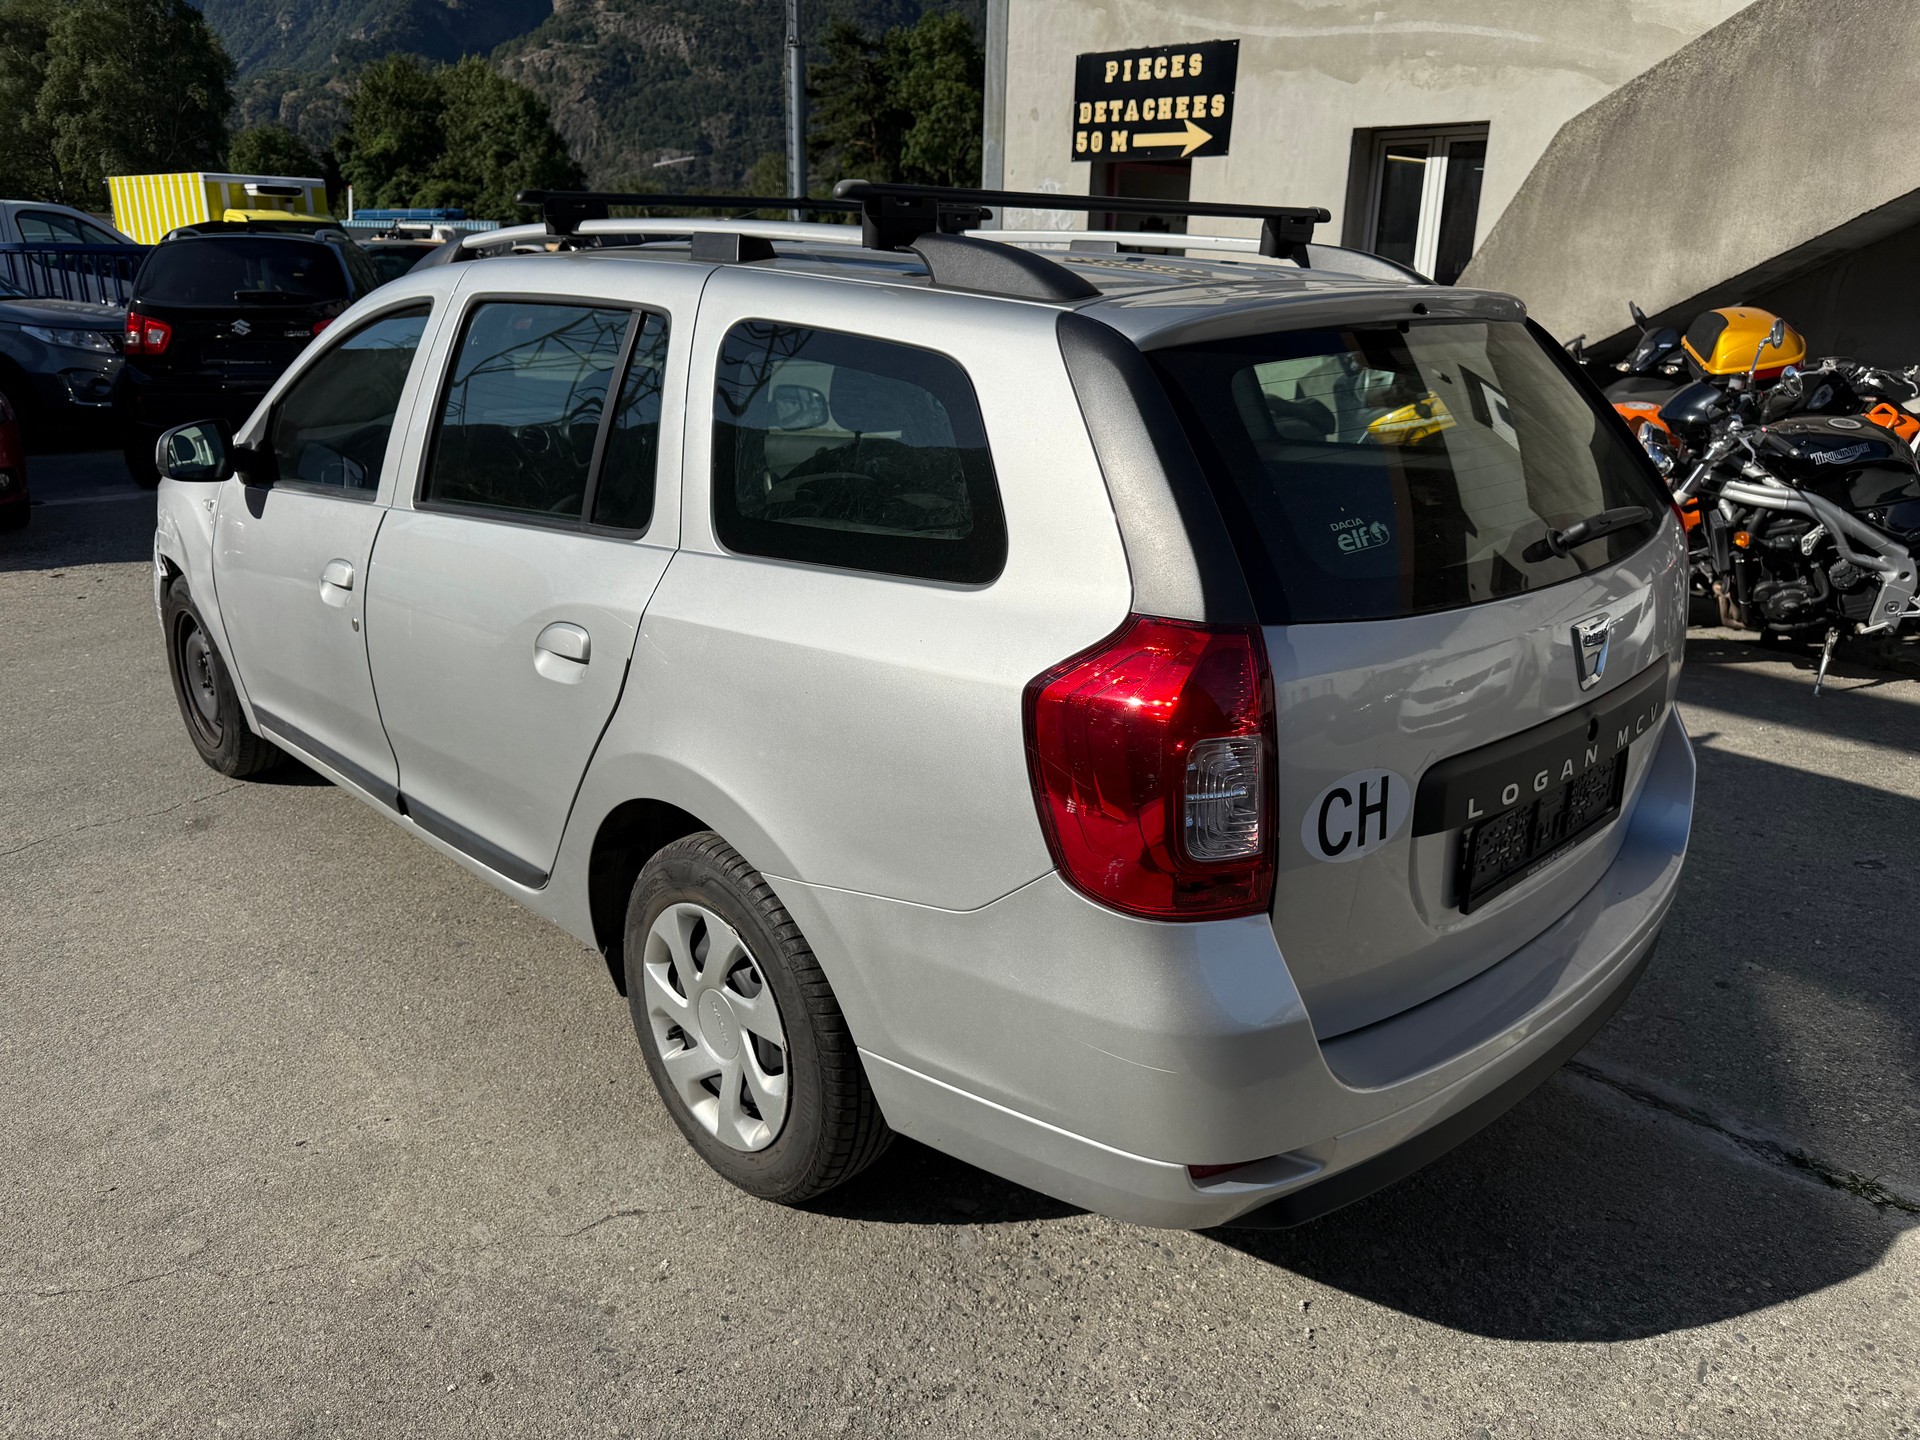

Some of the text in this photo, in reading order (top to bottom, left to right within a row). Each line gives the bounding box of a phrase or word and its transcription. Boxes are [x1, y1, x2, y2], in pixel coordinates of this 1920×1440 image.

[1105, 53, 1203, 83] PIECES
[1079, 94, 1225, 124] DETACHEES
[1076, 130, 1128, 153] 50 M
[1810, 443, 1870, 465] TRIUMPH
[1330, 517, 1364, 531] DACIA
[1338, 526, 1369, 551] elf
[1468, 703, 1658, 819] LOGAN MCV
[1318, 775, 1389, 856] CH
